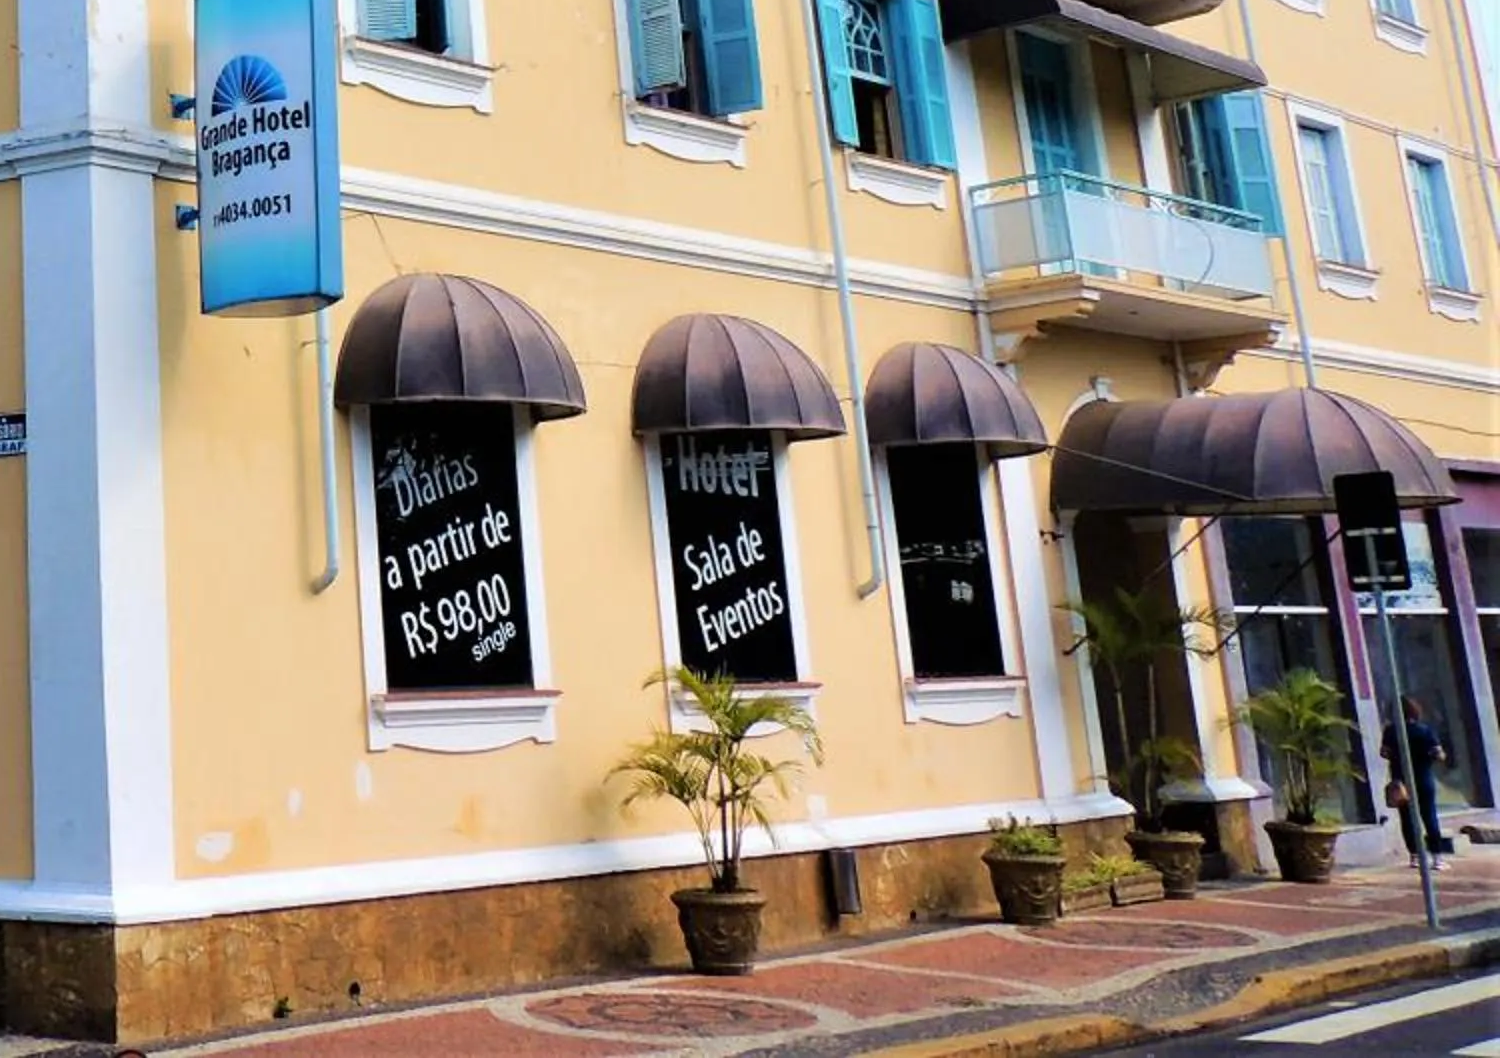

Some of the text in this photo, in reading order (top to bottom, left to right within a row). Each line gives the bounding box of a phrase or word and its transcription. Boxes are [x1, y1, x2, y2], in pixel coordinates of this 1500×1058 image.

[201, 101, 311, 152] Grande Hotel
[211, 140, 291, 178] Bragança
[392, 453, 479, 518] Diárias
[677, 434, 760, 498] Hotel
[384, 503, 512, 591] a partir de
[684, 521, 766, 591] Sala de
[471, 620, 517, 662] single
[696, 581, 784, 653] Eventos
